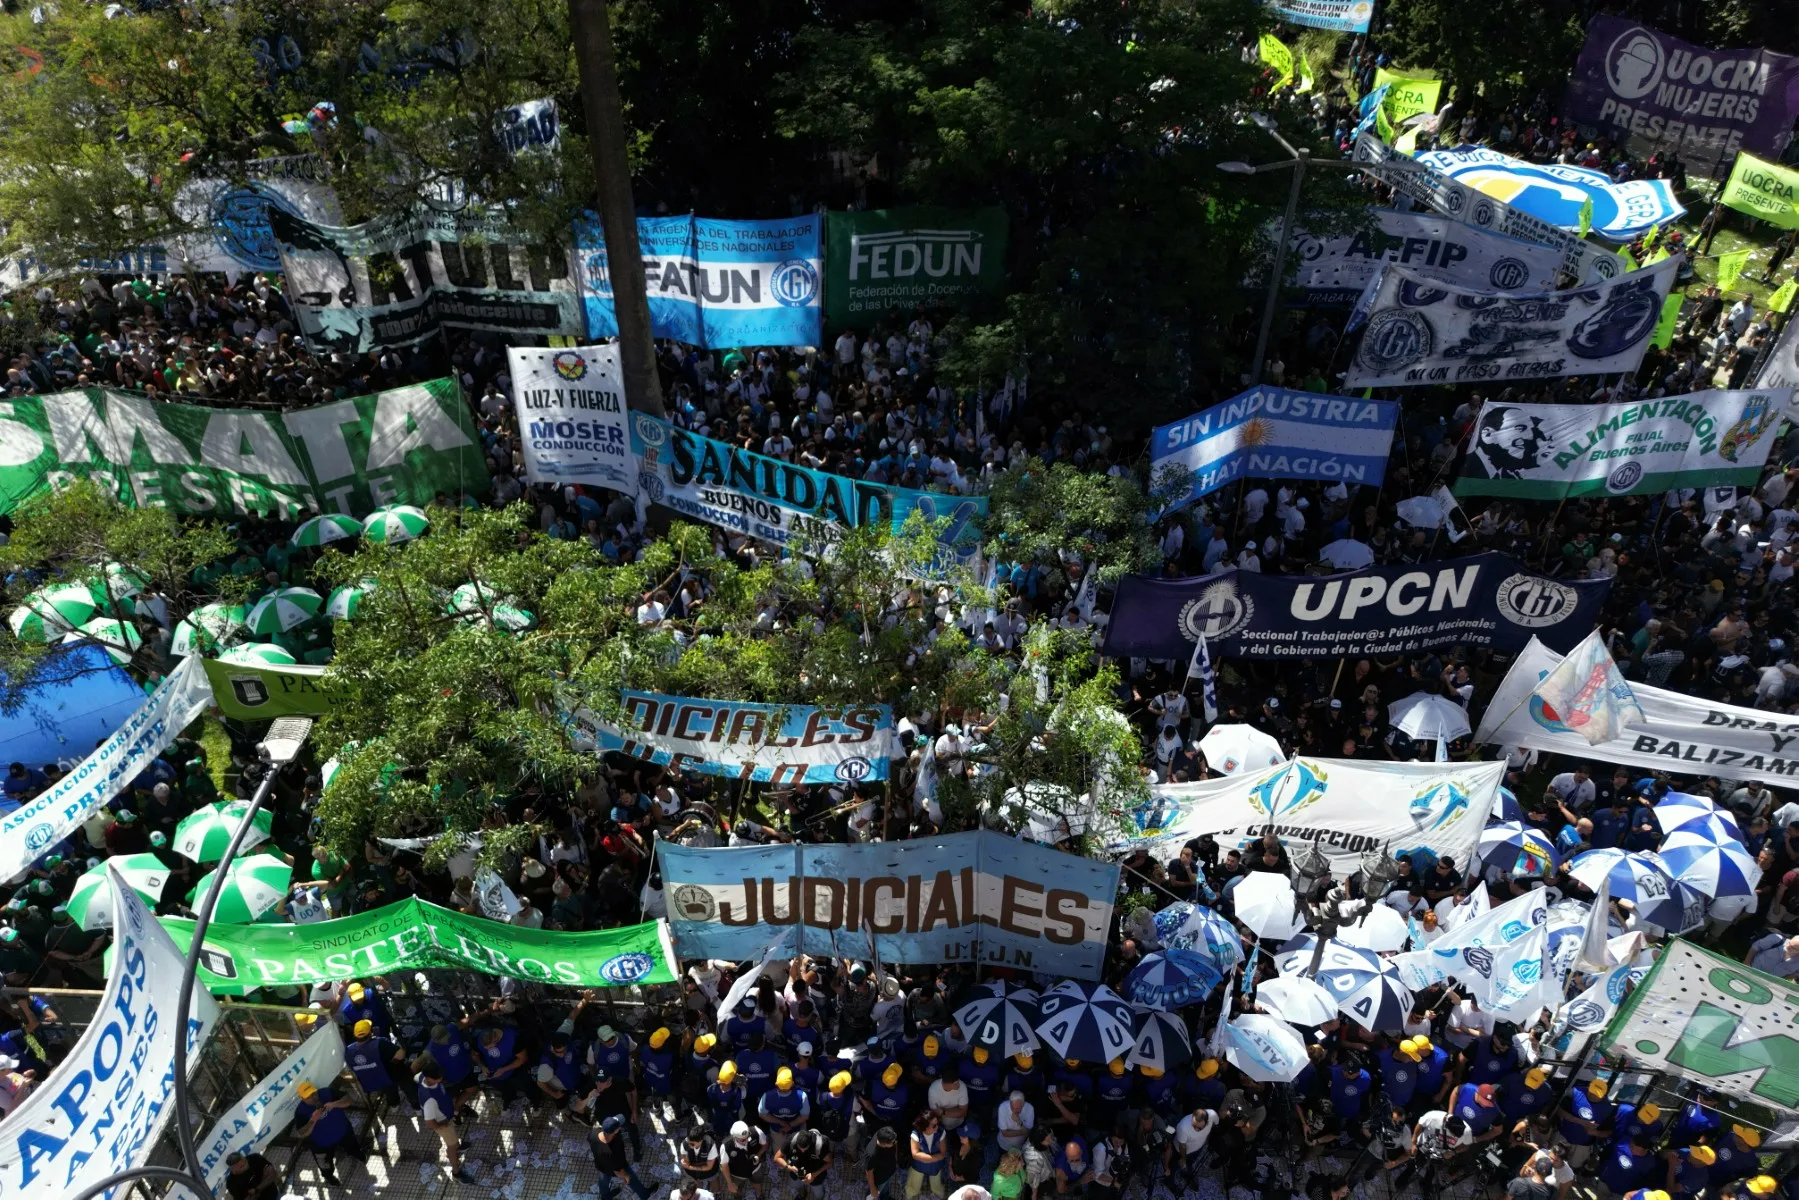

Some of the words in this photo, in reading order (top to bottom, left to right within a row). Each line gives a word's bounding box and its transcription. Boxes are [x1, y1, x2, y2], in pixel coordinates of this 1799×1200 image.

[1666, 48, 1770, 96] UOCRA
[1655, 81, 1760, 124] MUJERES
[1599, 98, 1744, 156] PRESENTE
[1736, 187, 1788, 215] PRESENTE
[1742, 168, 1794, 200] UOCRA
[709, 228, 731, 240] DEL
[736, 224, 813, 240] TRABAJADOR
[721, 240, 795, 252] NACIONALES
[849, 240, 982, 281] FEDUN
[643, 260, 762, 304] FATUN
[849, 283, 910, 298] Federación
[912, 284, 925, 296] de
[849, 300, 863, 312] de
[865, 299, 881, 310] las
[1430, 366, 1450, 380] UN
[1456, 363, 1501, 379] PASO
[1507, 358, 1566, 376] ATRAS
[524, 389, 552, 410] LUZ
[553, 389, 566, 410] Y
[569, 388, 621, 414] FUERZA
[530, 420, 624, 446] MOSER
[1167, 413, 1212, 449] SIN
[1218, 391, 1379, 428] INDUSTRIA
[1552, 399, 1718, 471] ALIMENTACIÓN
[1626, 429, 1664, 445] FILIAL
[532, 440, 625, 457] CONDUCCIÓN
[1588, 441, 1648, 463] Buenos
[1649, 438, 1690, 455] Aires
[670, 428, 894, 528] SANIDAD
[1201, 455, 1243, 491] HAY
[1248, 453, 1365, 481] NACIÓN
[704, 488, 782, 525] BUENOS
[790, 513, 838, 547] AIRE
[1290, 564, 1481, 621] UPCN
[1240, 645, 1247, 656] y
[1250, 644, 1269, 655] del
[1272, 643, 1327, 656] Gobierno
[1331, 644, 1345, 655] de
[1348, 642, 1360, 655] la
[1363, 640, 1402, 654] Ciudad
[1405, 639, 1419, 651] de
[1422, 635, 1457, 648] Buenos
[1460, 632, 1491, 645] Aires
[1241, 630, 1298, 642] Seccional
[1301, 629, 1385, 642] Trabajador@s
[1388, 624, 1434, 638] Públicos
[1437, 617, 1496, 631] Nacionales
[1770, 732, 1797, 753] Y
[3, 761, 98, 833] ASOCIACIÓN
[99, 711, 149, 762] OBRERA
[63, 719, 167, 821] PRESENTE
[1251, 775, 1325, 793] SETIA
[718, 867, 1089, 946] JUDICIALES
[312, 921, 390, 951] SINDICATO
[393, 912, 413, 928] DE
[417, 908, 514, 950] TRABAJADORES
[252, 923, 581, 983] PASTELEROS
[609, 959, 645, 979] CGT
[944, 940, 1039, 969] U.E.J.N.
[17, 935, 146, 1190] APOPS
[64, 1003, 158, 1190] ANSES
